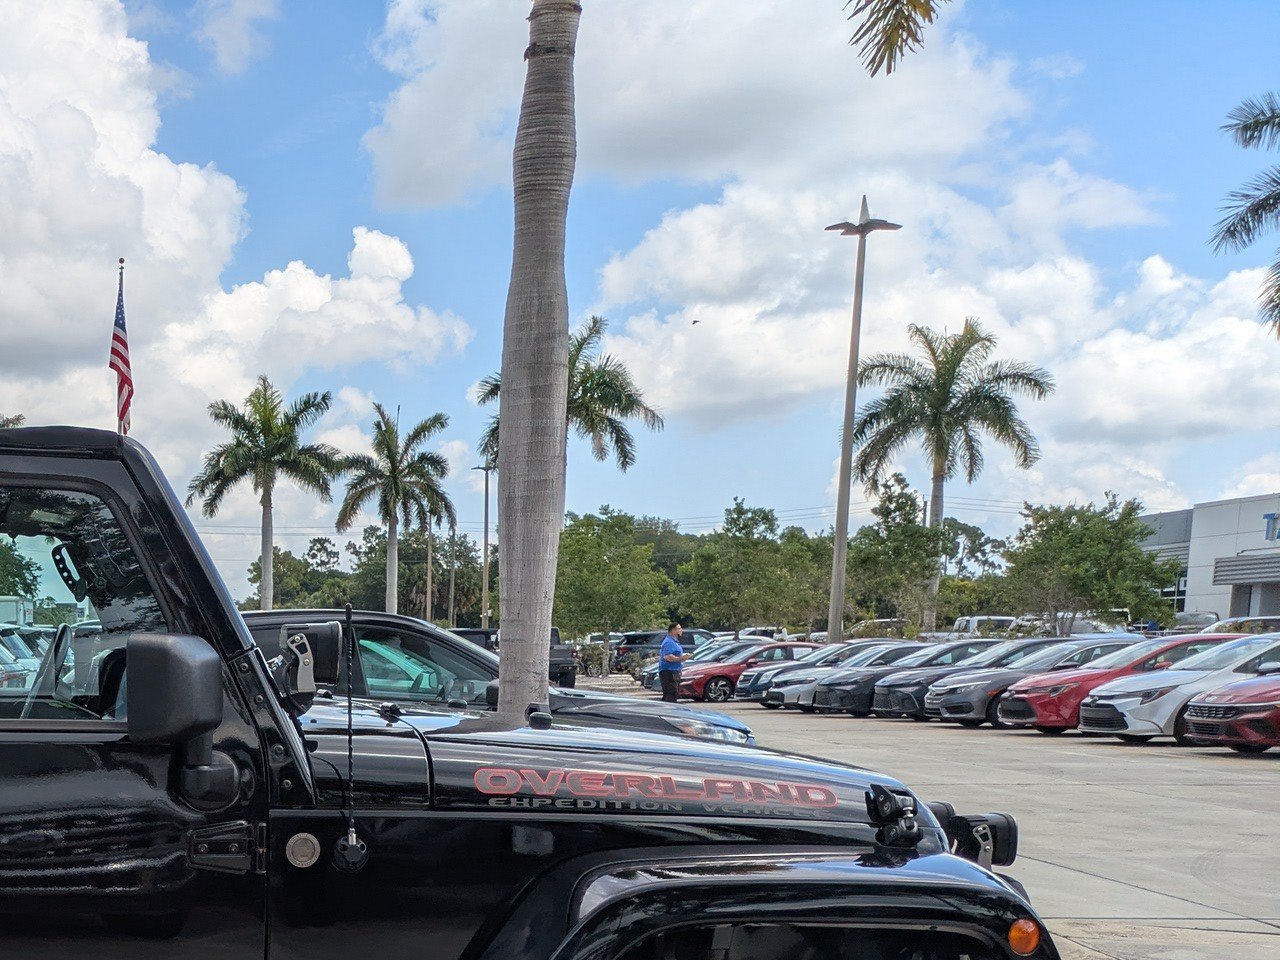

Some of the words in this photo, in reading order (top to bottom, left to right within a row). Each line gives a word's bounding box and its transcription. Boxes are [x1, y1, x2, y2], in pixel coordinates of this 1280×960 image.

[473, 767, 840, 808] OVERLAND
[488, 796, 683, 812] EXPEDITION
[702, 802, 830, 818] VEHICLE
